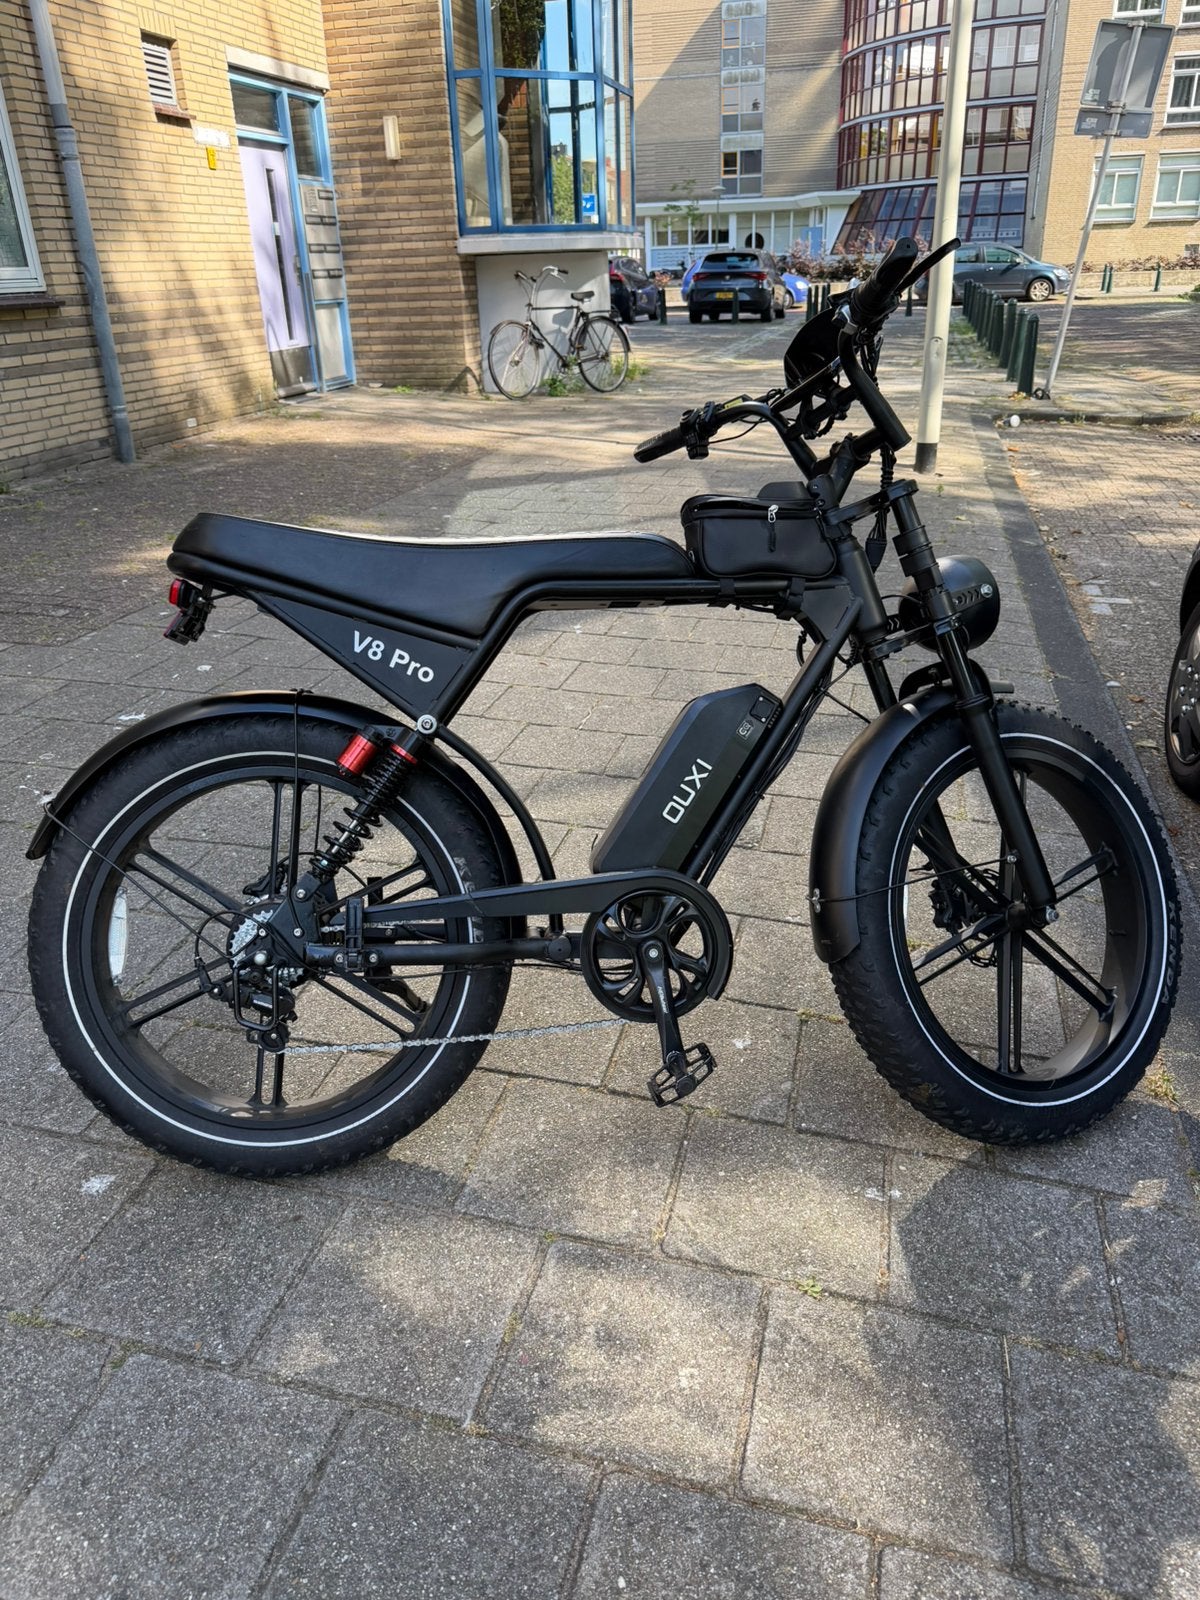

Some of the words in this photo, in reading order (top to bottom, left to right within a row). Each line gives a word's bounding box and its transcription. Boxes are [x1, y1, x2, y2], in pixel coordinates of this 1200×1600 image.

[354, 630, 385, 661] V8
[389, 648, 434, 683] Pro
[662, 758, 713, 824] OUXI
[1161, 900, 1177, 1004] KENDA
